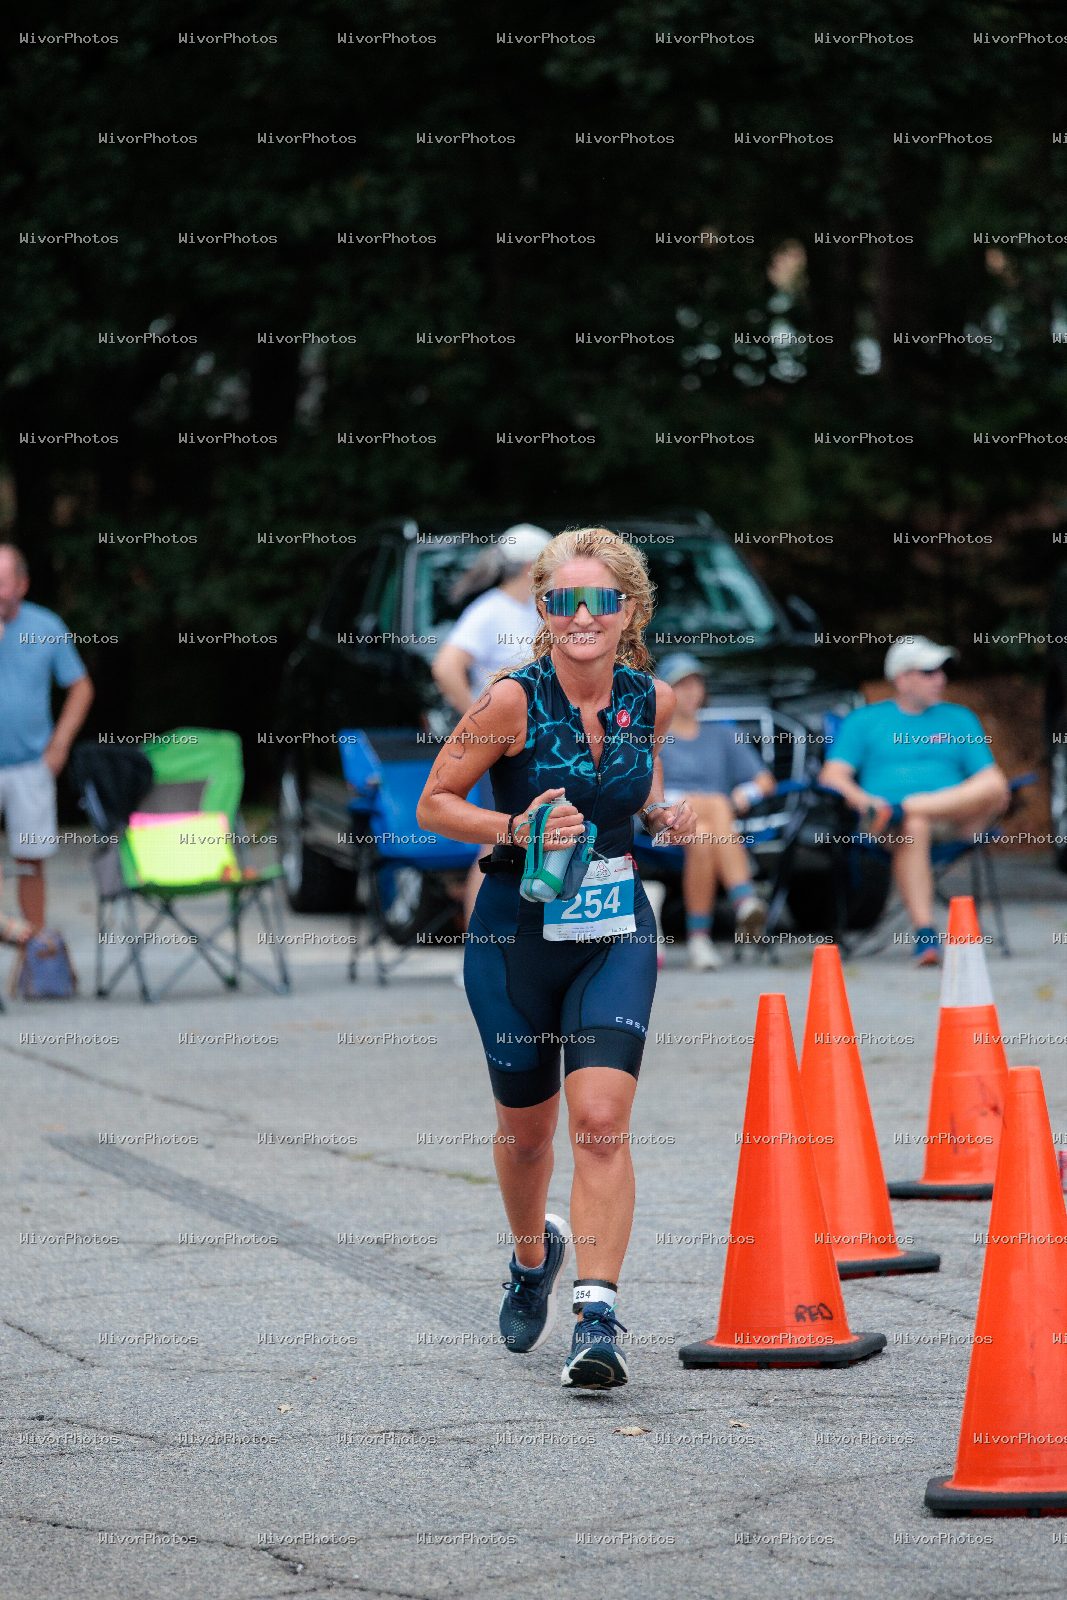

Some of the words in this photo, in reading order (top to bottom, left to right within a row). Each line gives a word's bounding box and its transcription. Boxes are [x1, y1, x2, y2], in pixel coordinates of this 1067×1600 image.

[560, 885, 621, 920] 254
[575, 1290, 592, 1300] 254
[795, 1303, 834, 1322] RED
